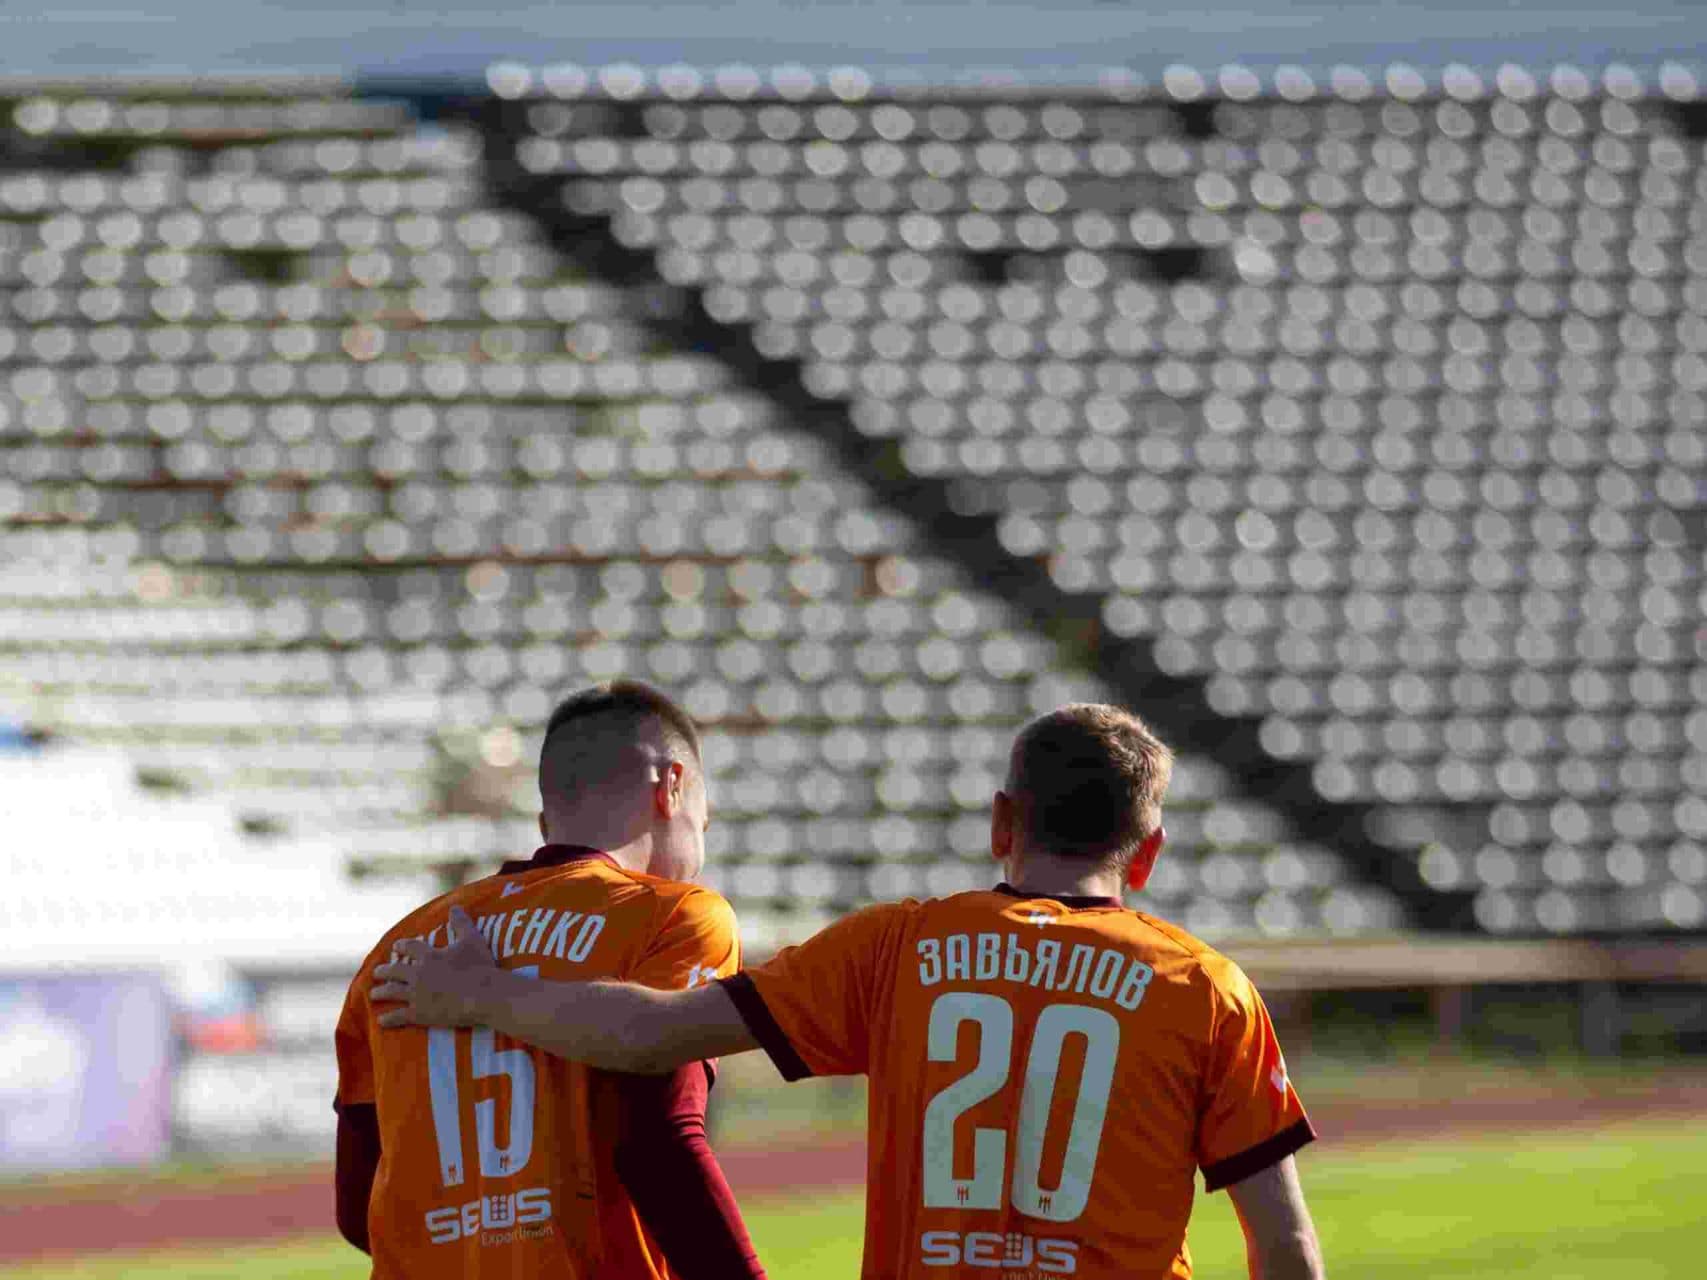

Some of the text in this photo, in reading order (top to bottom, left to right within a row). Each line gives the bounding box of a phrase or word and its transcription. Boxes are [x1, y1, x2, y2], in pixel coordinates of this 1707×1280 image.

[428, 966, 539, 1187] 15
[917, 933, 1154, 1011] ЗАВЬЯЛОВ
[924, 992, 1120, 1222] 20
